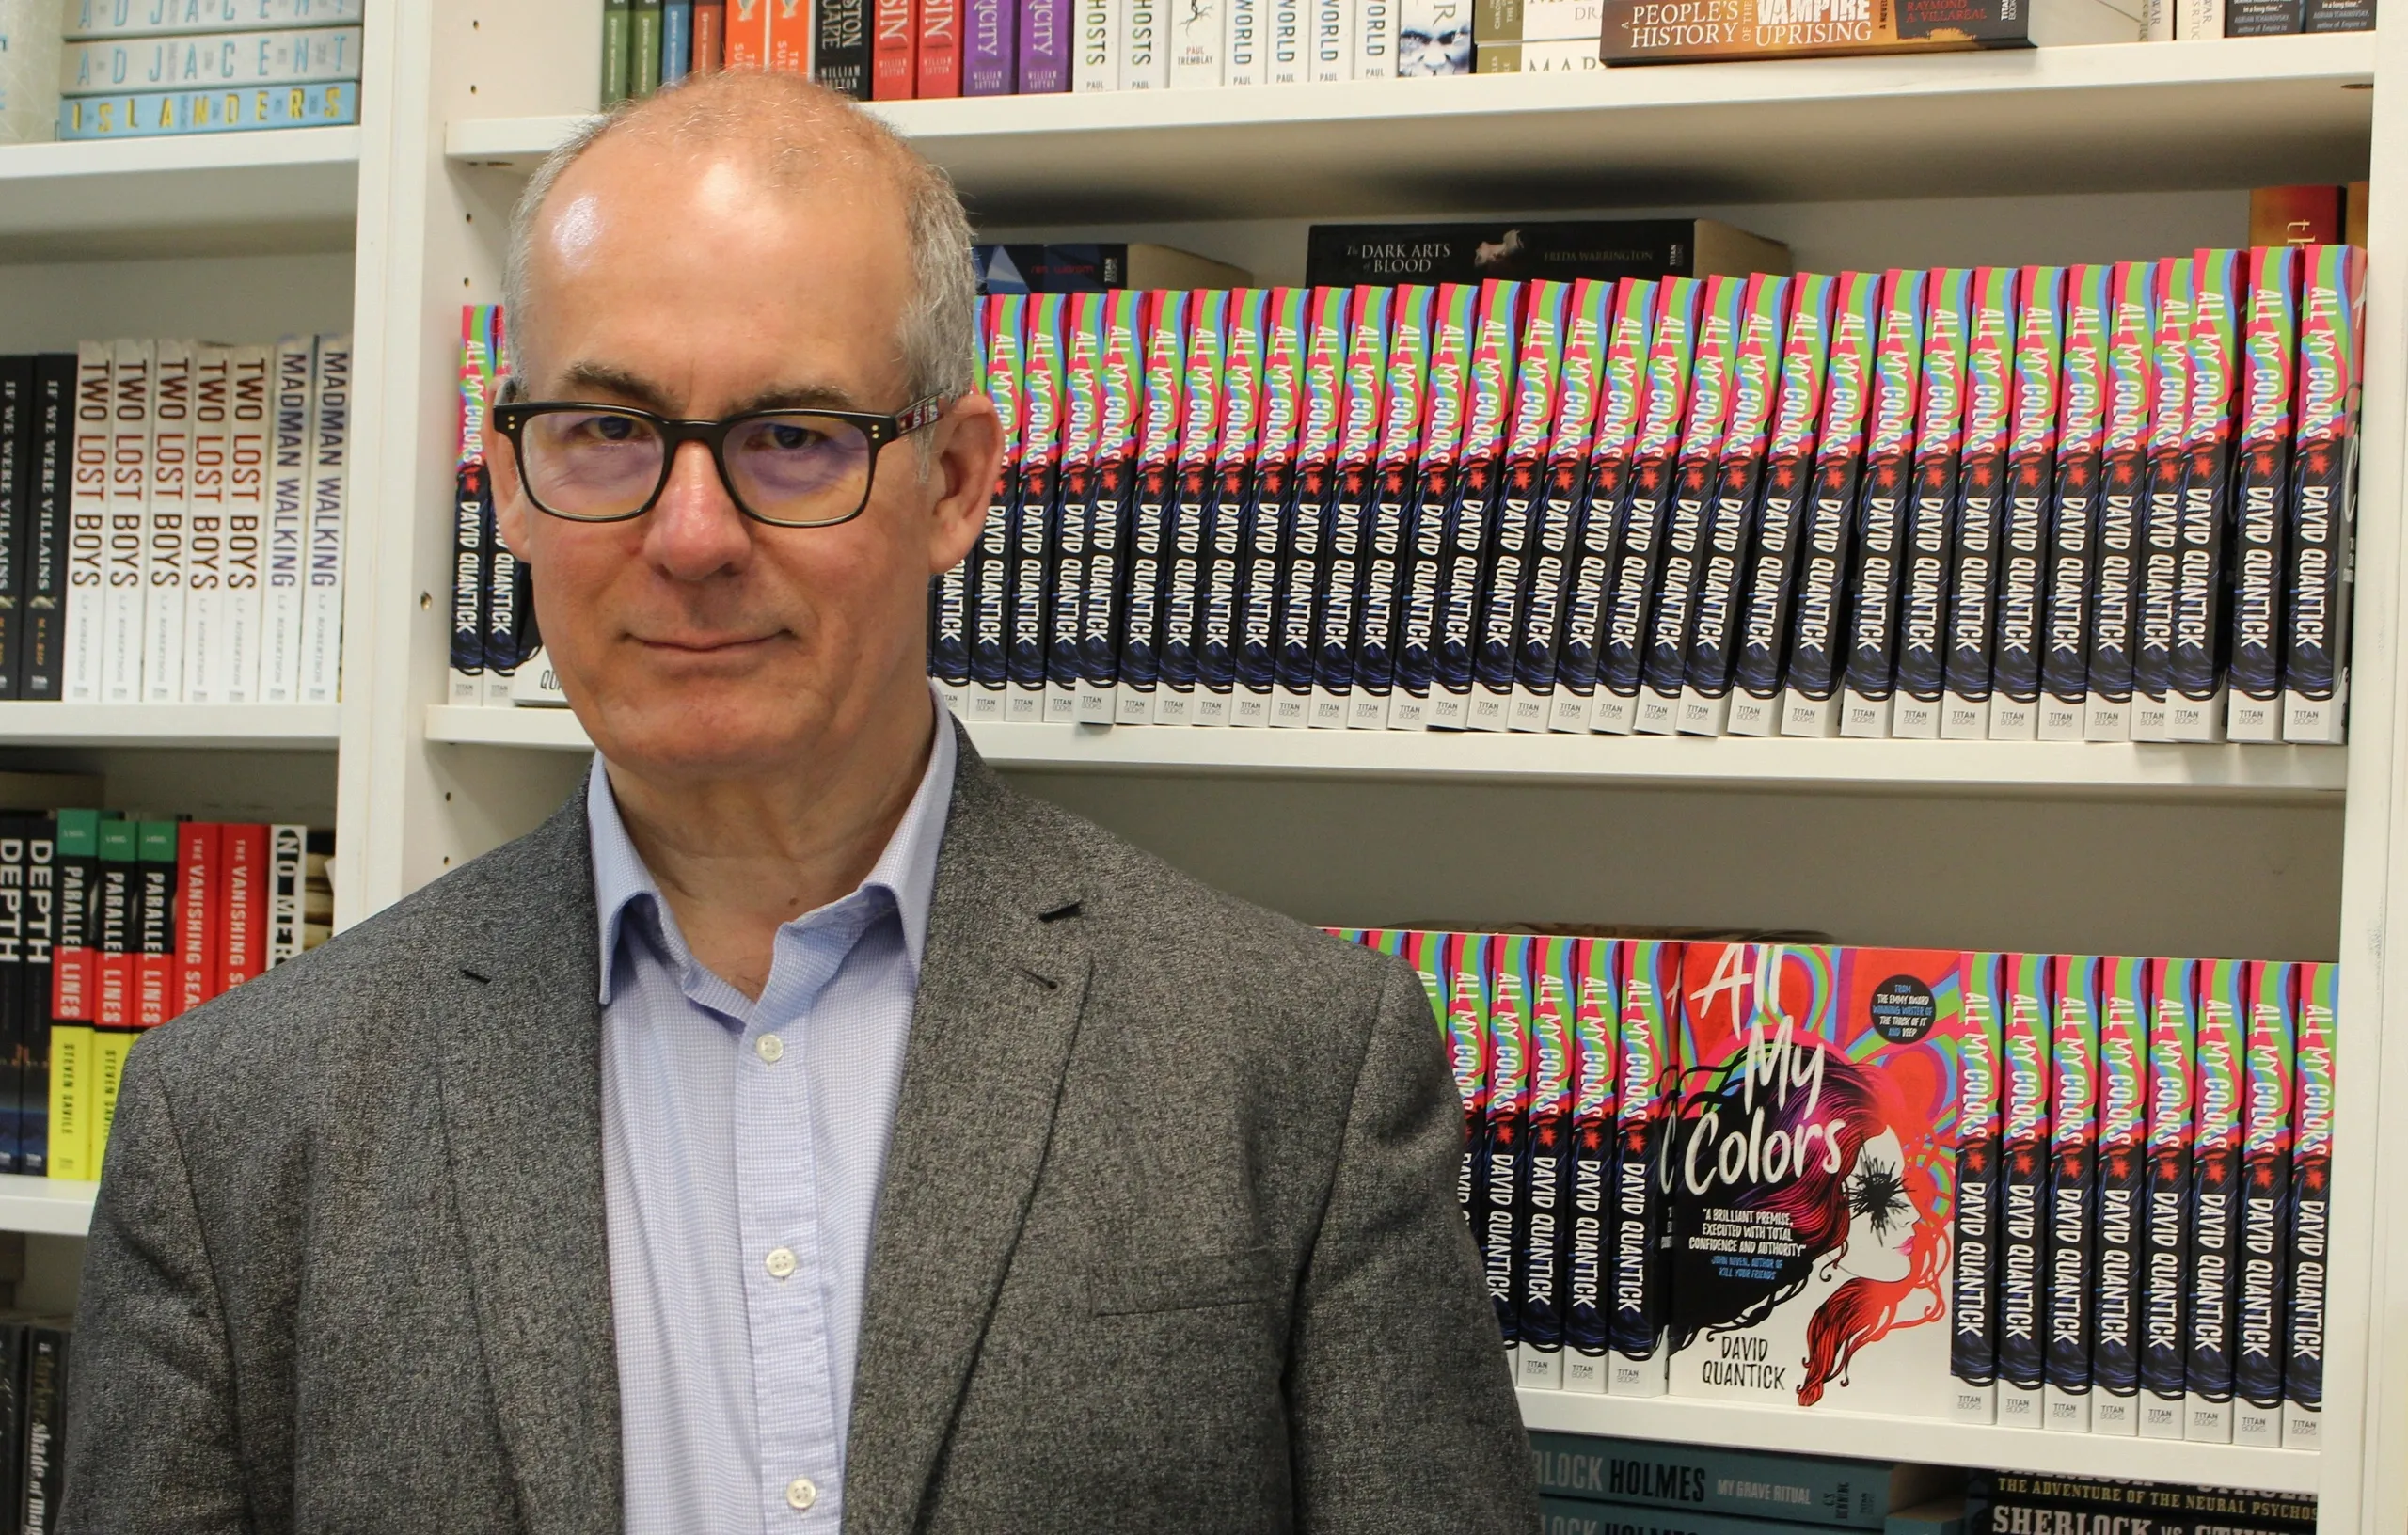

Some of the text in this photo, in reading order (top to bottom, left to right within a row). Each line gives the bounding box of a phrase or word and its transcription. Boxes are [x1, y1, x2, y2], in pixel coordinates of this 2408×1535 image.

[1631, 0, 1739, 25] PEOPLE'S
[1631, 23, 1739, 49] HISTORY
[1755, 22, 1872, 47] UPRISING
[1920, 8, 1988, 23] VILLAREAL
[77, 35, 347, 86] ADJACENT
[1177, 55, 1213, 66] TREMBLAY
[1185, 45, 1205, 55] PAUL
[1233, 76, 1252, 86] PAUL
[1276, 73, 1294, 83] PAUL
[71, 87, 341, 134] ISLANDERS
[1361, 244, 1406, 259] DARK
[1411, 243, 1451, 258] ARTS
[1373, 259, 1433, 273] BLOOD
[79, 359, 111, 423] TWO
[158, 357, 189, 422] TWO
[277, 353, 307, 467] MADMAN
[318, 351, 348, 467] MADMAN
[38, 380, 59, 592] IF WE WERE VILLAINS
[75, 434, 107, 502] LOST
[109, 359, 148, 589] TWO LOST BOYS
[154, 434, 186, 501] LOST
[227, 358, 265, 590] TWO LOST BOYS
[456, 340, 486, 635] ALL MY COLORS DAVID QUANTICK
[1205, 327, 1257, 648] ALL MY COLORS DAVID QUANTICK
[1485, 318, 1555, 648] ALL MY COLORS DAVID QUANTICK
[1856, 310, 1913, 653] ALL MY COLORS DAVID QUANTICK
[2295, 287, 2338, 649] ALL MY COLORS DAVID QUANTICK
[71, 514, 103, 589] BOYS
[150, 514, 182, 589] BOYS
[270, 477, 302, 588] WALKING
[310, 476, 342, 587] WALKING
[1517, 703, 1540, 711] TITAN
[276, 836, 299, 876] NO
[0, 838, 23, 964] DEPTH
[27, 840, 54, 965] DEPTH
[186, 864, 206, 965] VANISHING
[229, 865, 248, 968] VANISHING
[59, 865, 84, 1021] PARALLEL LINES
[102, 871, 125, 1024] PARALLEL LINES
[141, 871, 166, 1025] PARALLEL LINES
[1689, 943, 1784, 1041] All
[62, 1042, 76, 1091] STEVEN
[1744, 1015, 1826, 1121] My
[1528, 974, 1564, 1306] ALL MY COLORS DAVID QUANTICK
[1684, 1106, 1847, 1195] Colors
[2148, 998, 2185, 1351] ALL MY COLORS DAVID QUANTICK
[1688, 1236, 1737, 1252] CONFIDENCE
[1739, 1240, 1756, 1254] AND
[1702, 1223, 1793, 1242] EXECUTED WITH TOTAL
[1712, 1208, 1755, 1224] BRILLIANT
[1755, 1211, 1794, 1227] PREMISE,
[1526, 1360, 1549, 1369] TITAN
[1702, 1360, 1786, 1391] QUANTICK
[1720, 1335, 1768, 1361] DAVID
[1609, 1458, 1706, 1503] HOLMES
[1717, 1478, 1734, 1496] MY
[1736, 1480, 1771, 1500] GRAVE
[1773, 1482, 1812, 1505] RITUAL
[1997, 1477, 2028, 1494] THE
[2032, 1480, 2122, 1503] ADVENTURE
[2126, 1489, 2147, 1505] OF
[2150, 1491, 2180, 1509] THE
[2185, 1494, 2247, 1517] NEURAL
[1991, 1504, 2153, 1535] SHERLOCK
